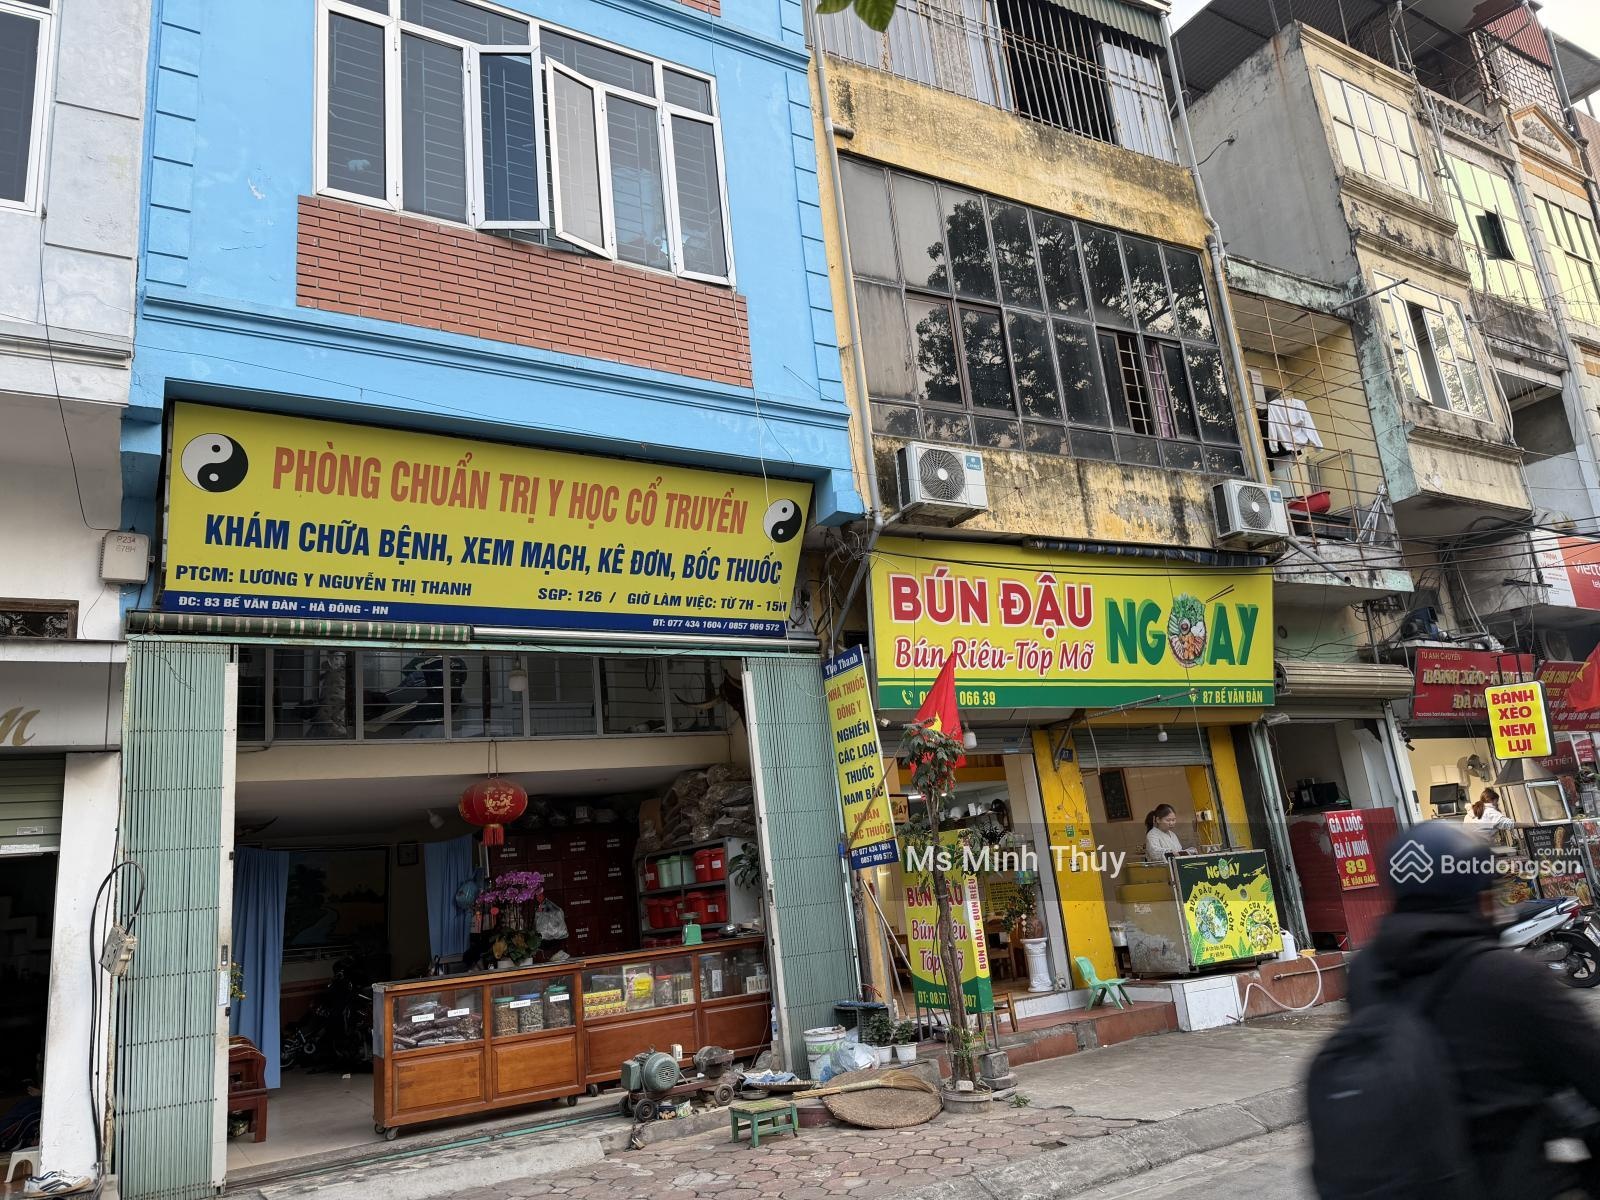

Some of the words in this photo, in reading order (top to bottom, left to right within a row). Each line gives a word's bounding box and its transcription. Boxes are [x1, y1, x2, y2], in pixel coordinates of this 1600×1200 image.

[273, 441, 382, 499] PHÒNG
[390, 452, 491, 510] CHUẨN
[499, 473, 540, 523] TRỊ
[548, 478, 564, 517] Y
[568, 482, 619, 529] HỌC
[625, 476, 663, 527] CỔ
[664, 487, 748, 535] TRUYỀN
[204, 511, 290, 550] KHÁM
[299, 519, 370, 556] CHỮA
[378, 525, 452, 566] BỆNH,
[460, 536, 514, 566] XEM
[520, 540, 590, 575] MẠCH,
[597, 543, 625, 575] KÊ
[630, 549, 676, 581] ĐƠN,
[682, 547, 720, 581] BỐC
[726, 551, 783, 585] THUỐC
[175, 565, 233, 583] PTCM:
[240, 569, 298, 587] LƯƠNG
[303, 573, 314, 587] Y
[318, 572, 386, 592] NGUYỄN
[391, 578, 416, 596] THỊ
[420, 580, 472, 596] THANH
[178, 597, 201, 607] ĐC:
[204, 598, 220, 608] 83
[223, 597, 240, 608] BẾ
[243, 598, 268, 610] VĂN
[272, 599, 297, 610] ĐÀN
[309, 600, 325, 612] HÀ
[328, 601, 361, 614] ĐÔNG
[372, 605, 389, 615] HN
[537, 587, 572, 602] SGP:
[577, 590, 602, 603] 126
[627, 592, 651, 605] GIỜ
[653, 592, 681, 607] LÀM
[685, 594, 717, 610] VIỆC:
[720, 595, 737, 610] TỪ
[739, 599, 754, 611] 7H
[765, 600, 787, 612] 15H
[891, 568, 989, 626] BÚN
[999, 573, 1093, 640] ĐẬU
[667, 619, 683, 627] 077
[684, 620, 700, 628] 434
[702, 621, 722, 629] 1604
[728, 622, 748, 631] 0857
[765, 623, 780, 632] 572
[838, 653, 859, 670] Thanh
[895, 637, 954, 669] Bún
[1059, 641, 1095, 672] Mỡ
[828, 684, 842, 702] NHÀ
[842, 674, 865, 695] THUỐC
[1203, 690, 1213, 704] 87
[1215, 687, 1226, 704] BẾ
[1228, 688, 1245, 704] VĂN
[1246, 688, 1263, 704] ĐÀN
[1491, 689, 1534, 705] BÁNH
[960, 691, 980, 706] 066
[983, 691, 997, 706] 39
[836, 702, 856, 720] ĐÔNG
[856, 700, 862, 712] Y
[1498, 704, 1532, 721] XÈO
[837, 718, 870, 744] NGHIỀN
[1499, 723, 1536, 737] NEM
[838, 748, 856, 764] CÁC
[857, 741, 878, 758] LOẠI
[1508, 739, 1532, 755] LỤI
[845, 762, 875, 785] THUỐC
[843, 790, 864, 806] NAM
[865, 822, 890, 838] THUỐC
[1329, 814, 1342, 833] GÀ
[1333, 839, 1346, 859] GÀ
[1345, 859, 1367, 874] 89
[912, 919, 936, 940] Bún
